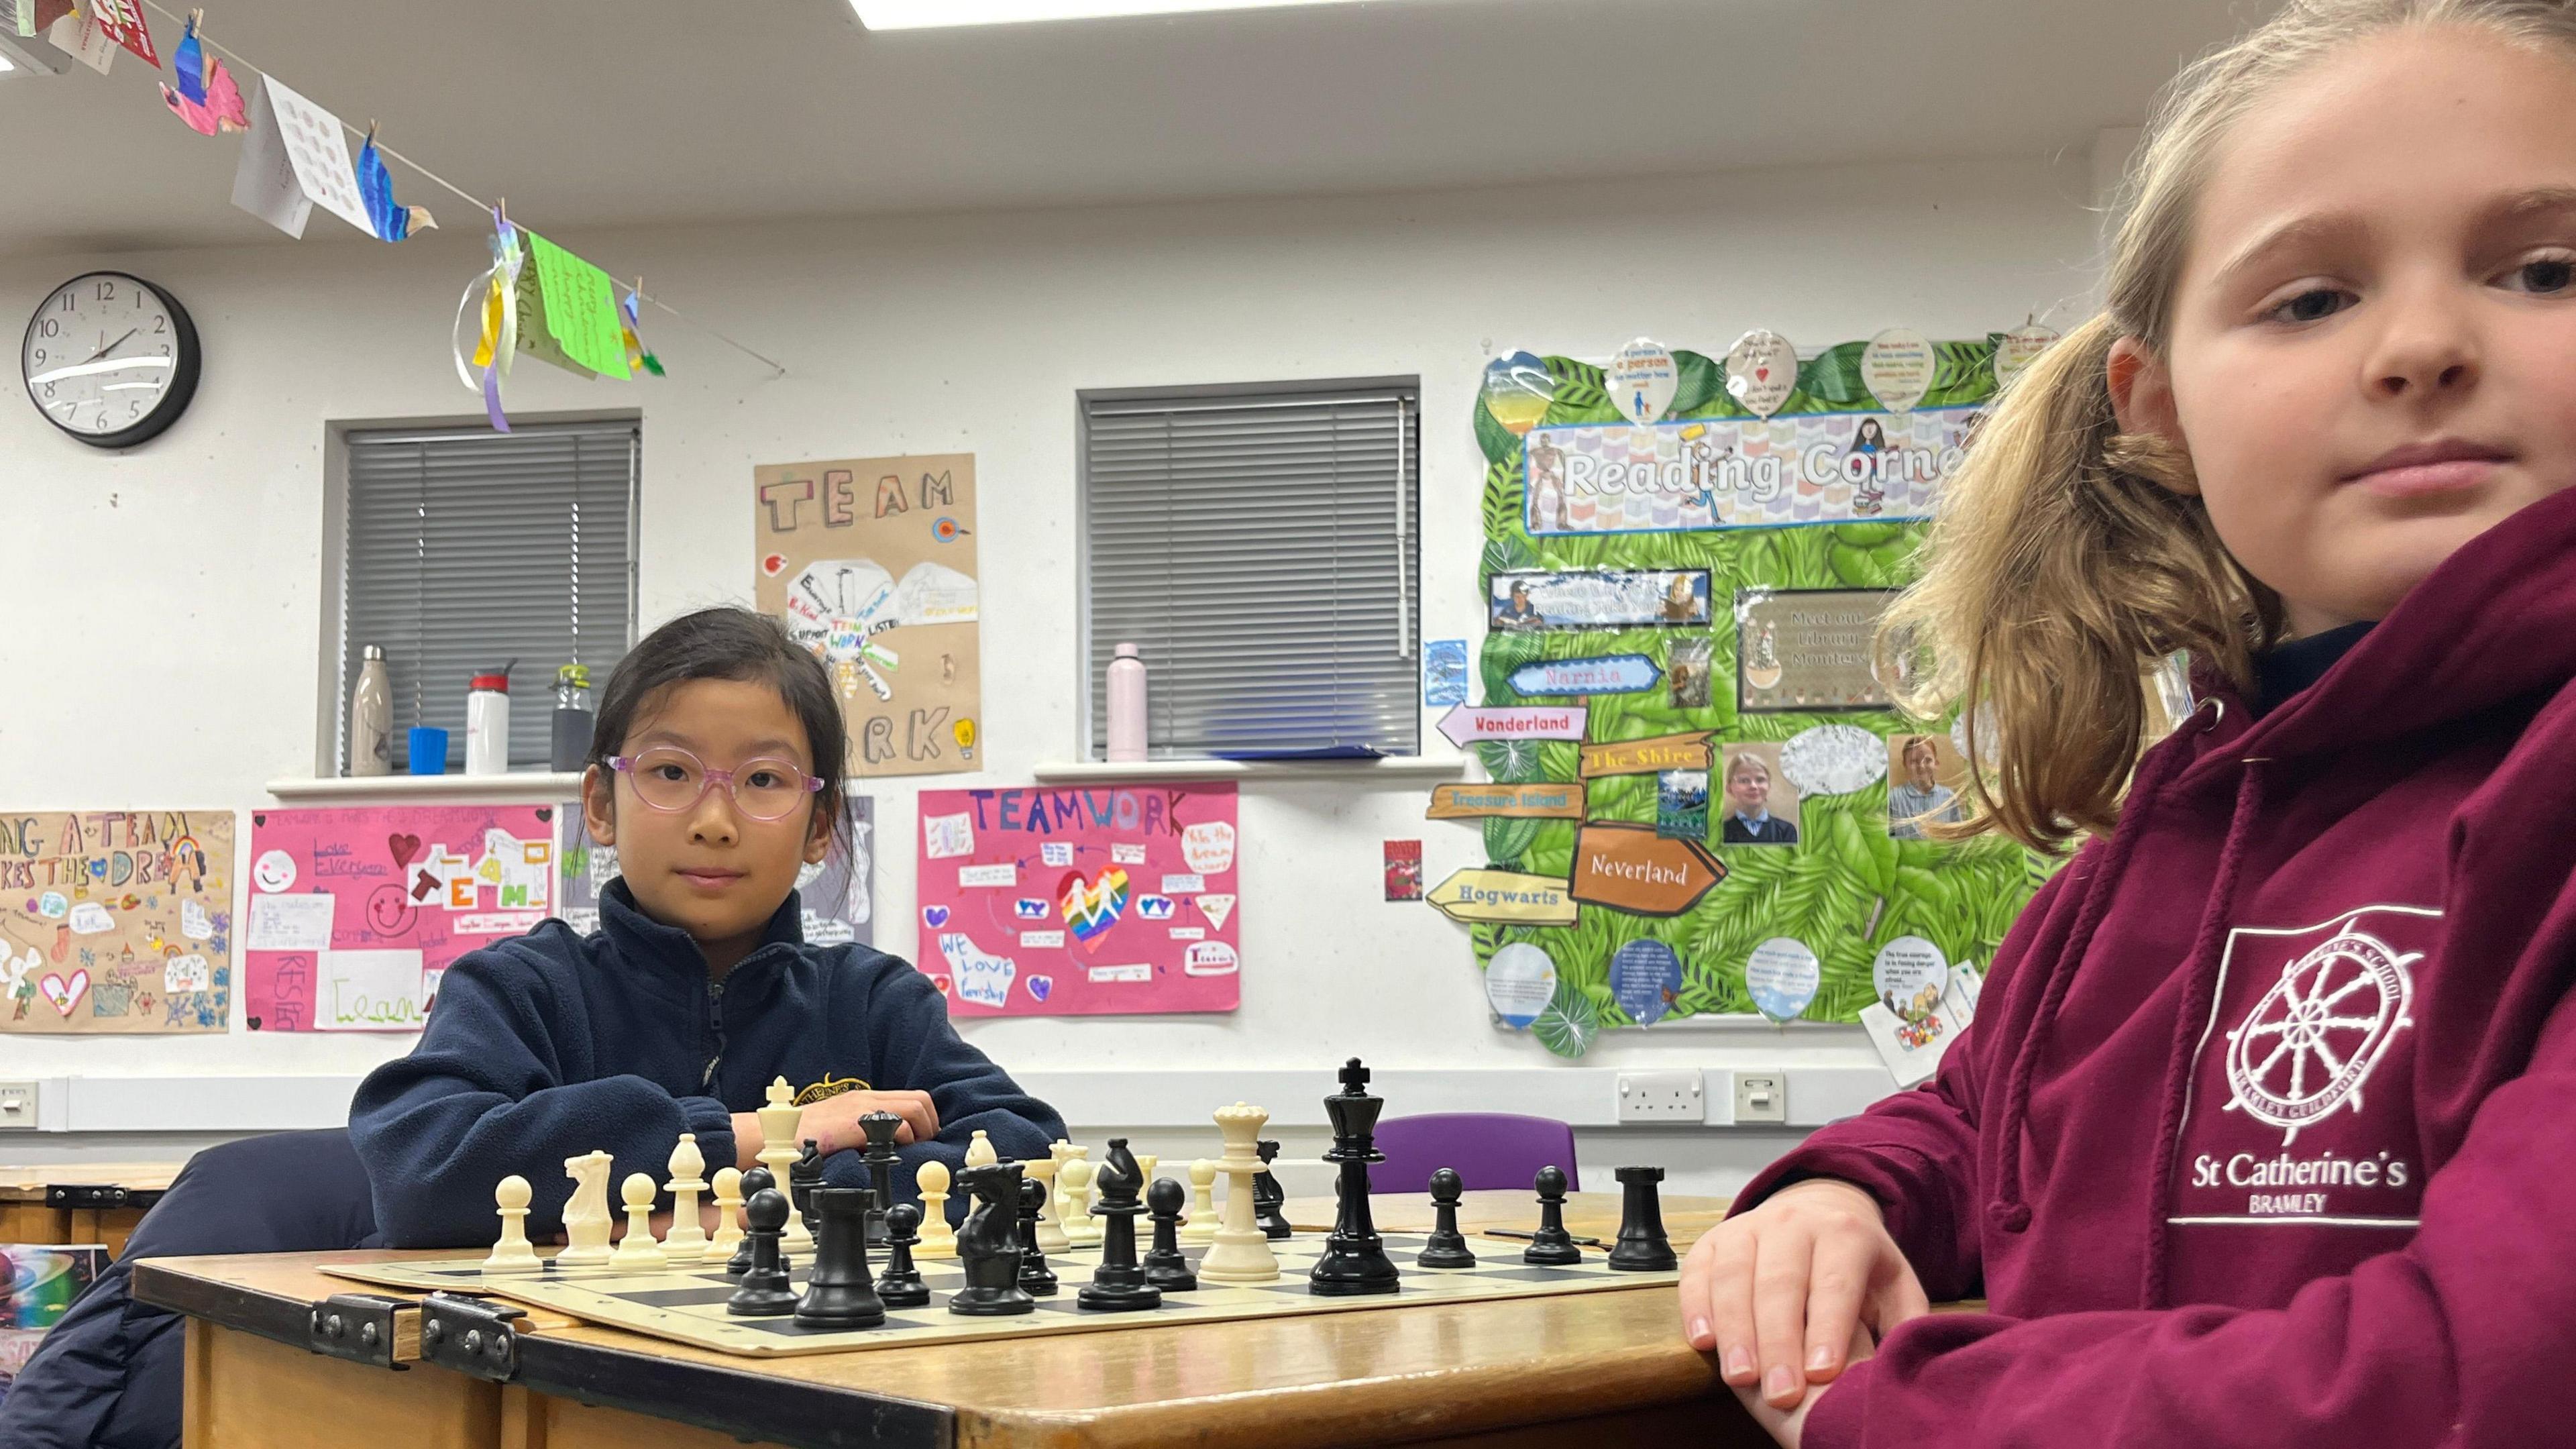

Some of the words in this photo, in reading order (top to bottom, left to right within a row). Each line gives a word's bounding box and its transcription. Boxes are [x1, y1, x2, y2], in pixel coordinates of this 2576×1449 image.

[96, 282, 115, 301] 12
[136, 291, 142, 309] 1
[62, 293, 75, 311] 11
[39, 318, 59, 337] 10
[154, 315, 166, 335] 2
[35, 348, 46, 367] 9
[1627, 358, 1668, 372] person
[44, 381, 56, 398] 8
[66, 402, 78, 421] 7
[128, 400, 140, 419] 5
[96, 410, 108, 429] 6
[1562, 445, 1783, 504] Reading
[760, 469, 955, 533] TEAM
[1790, 610, 1831, 626] Meet
[1835, 613, 1862, 626] our
[1797, 631, 1860, 647] Library
[1546, 669, 1623, 686] Narnia
[1476, 715, 1569, 733] Wonderland
[864, 706, 951, 764] RK
[1590, 751, 1627, 769] The
[1637, 747, 1694, 765] Shire
[1452, 790, 1517, 807] Treasure
[1521, 791, 1567, 808] Island
[968, 789, 1187, 838] TEAMWORK
[58, 812, 84, 855] A
[313, 837, 353, 857] Love
[38, 855, 89, 887] THE
[1591, 853, 1689, 886] Neverland
[411, 857, 527, 907] TEAM
[1458, 885, 1559, 906] Hogwarts
[941, 934, 967, 956] WE
[961, 959, 1013, 977] LOVE
[2192, 1154, 2221, 1187] St
[2226, 1148, 2409, 1187] Catherine's
[2249, 1192, 2328, 1214] BRAMLEY
